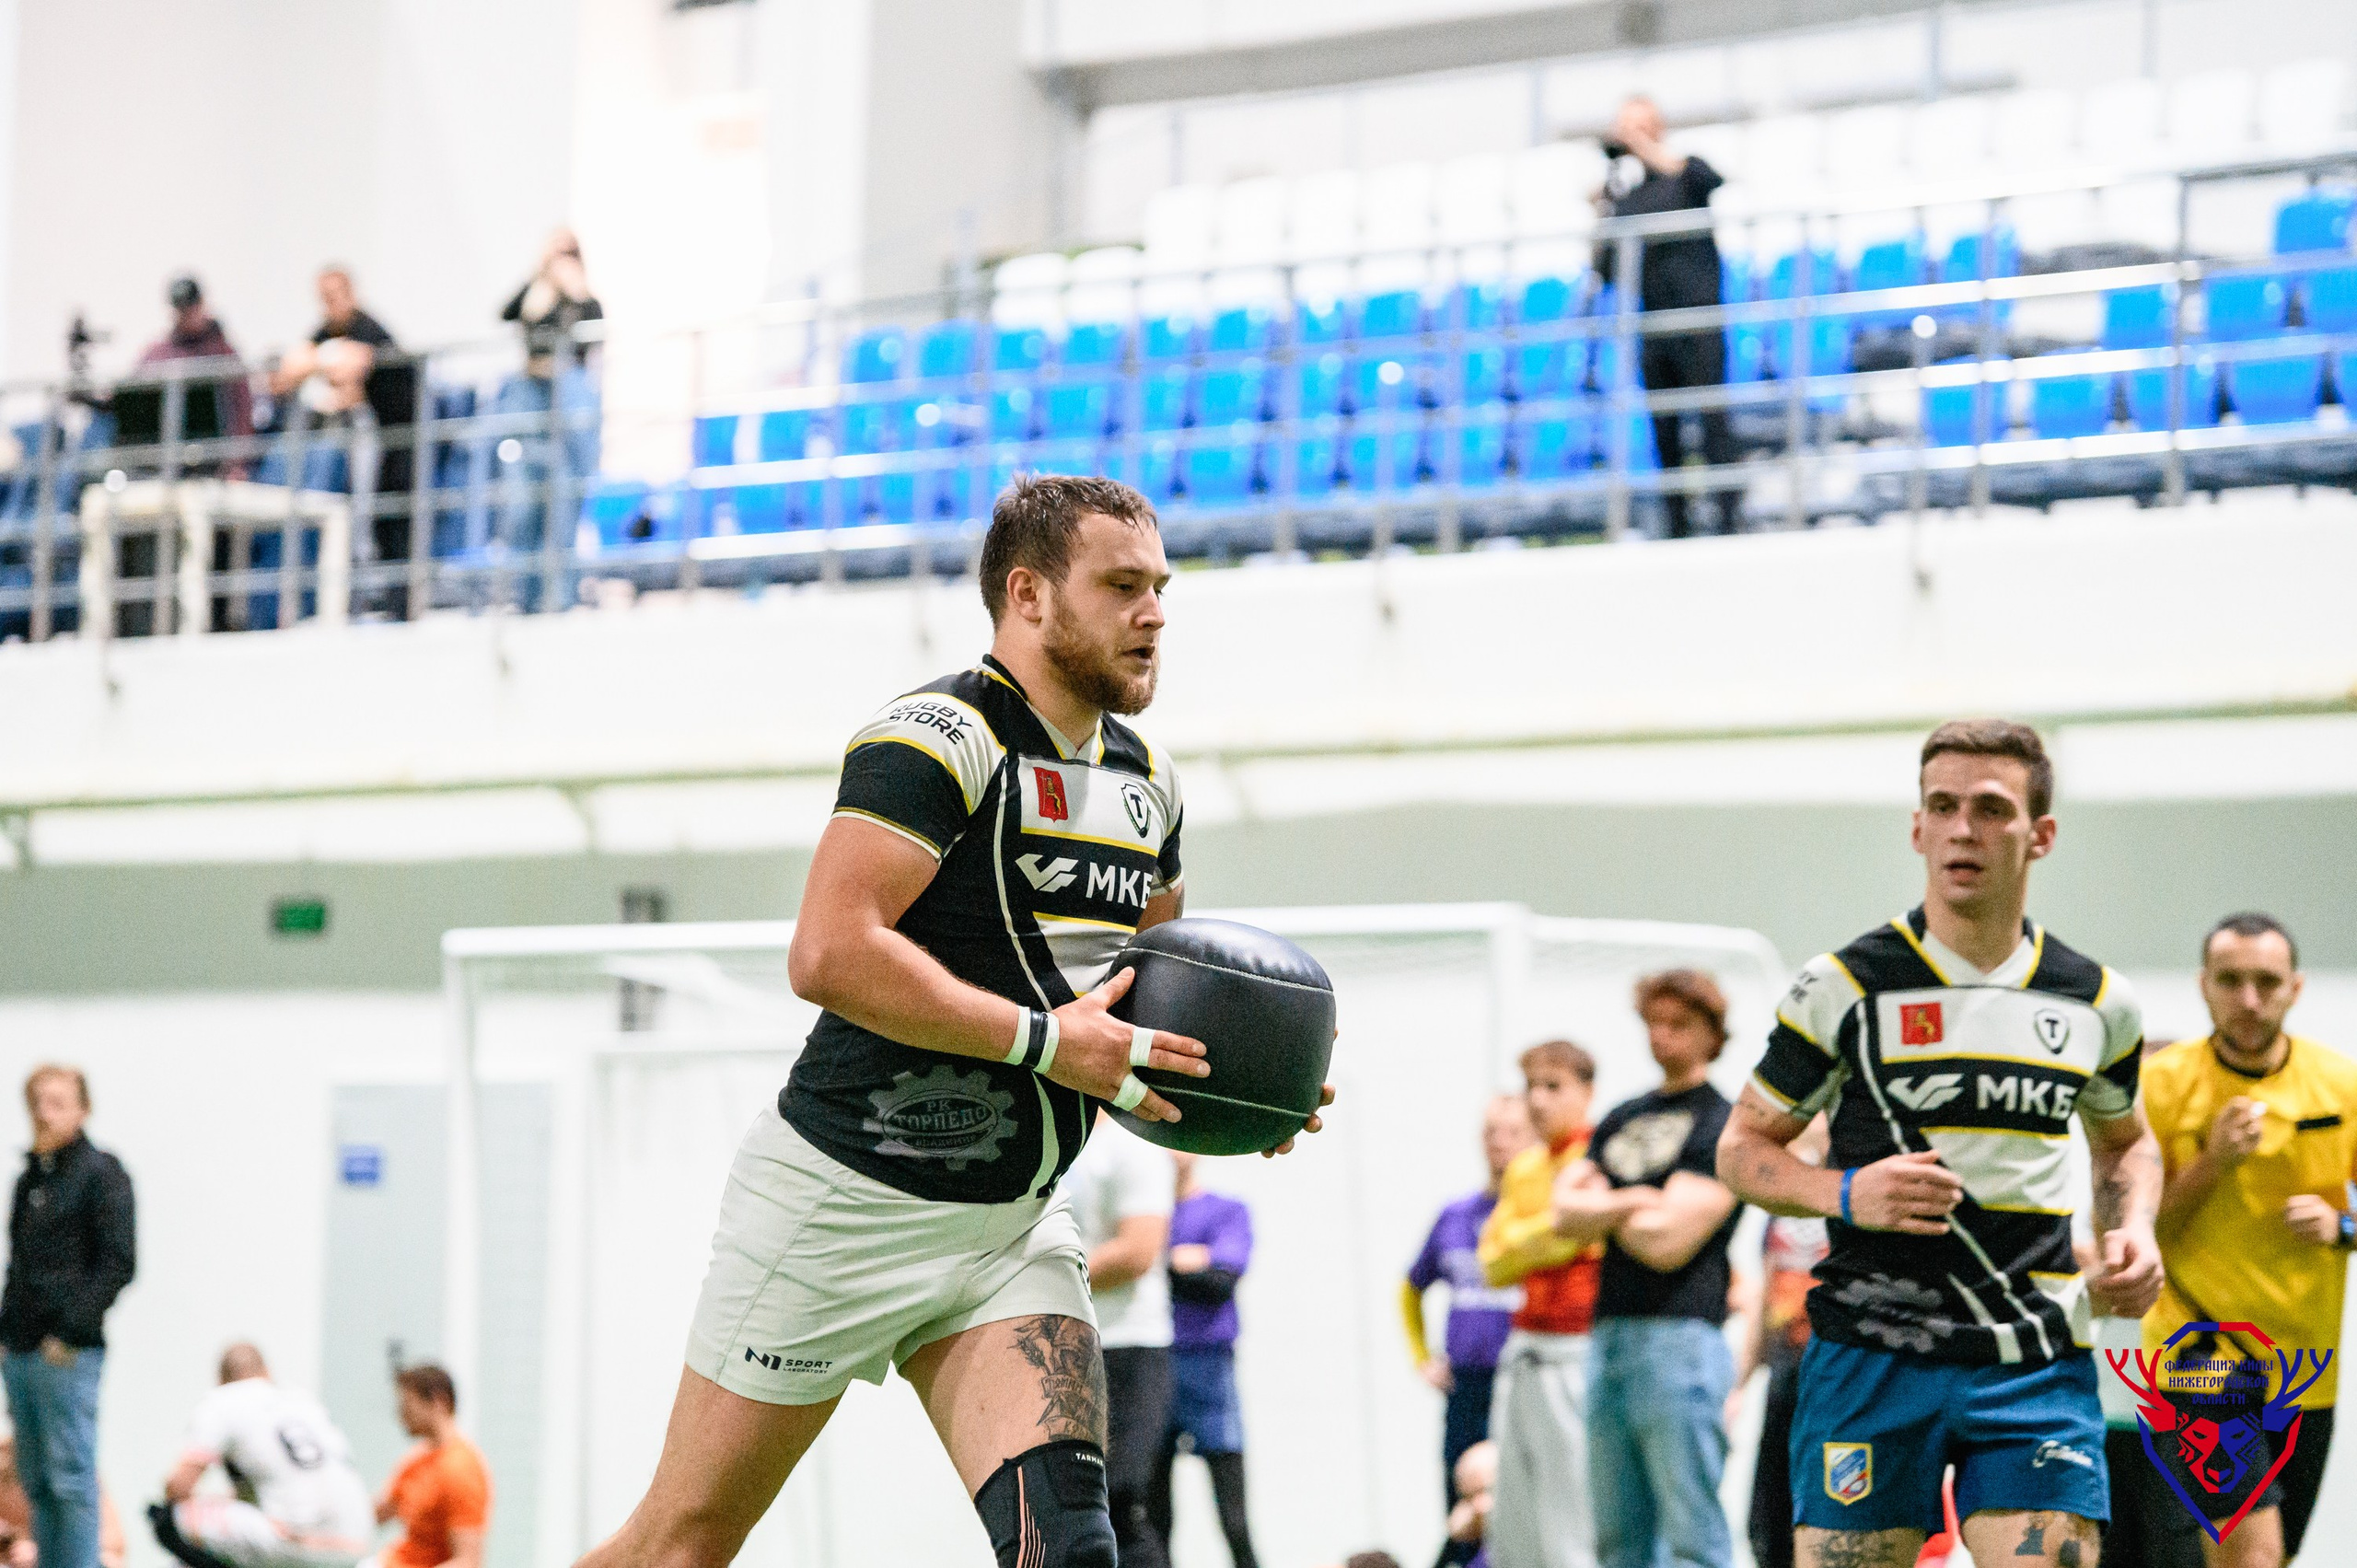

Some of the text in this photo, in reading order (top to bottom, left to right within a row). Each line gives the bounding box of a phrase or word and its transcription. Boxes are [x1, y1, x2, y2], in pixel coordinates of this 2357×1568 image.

[889, 702, 972, 726] RUGBY
[885, 712, 965, 745] STORE
[1977, 1074, 2078, 1121] МКБ
[893, 1105, 988, 1131] ТОРПЕДО
[785, 1359, 833, 1368] SPORT
